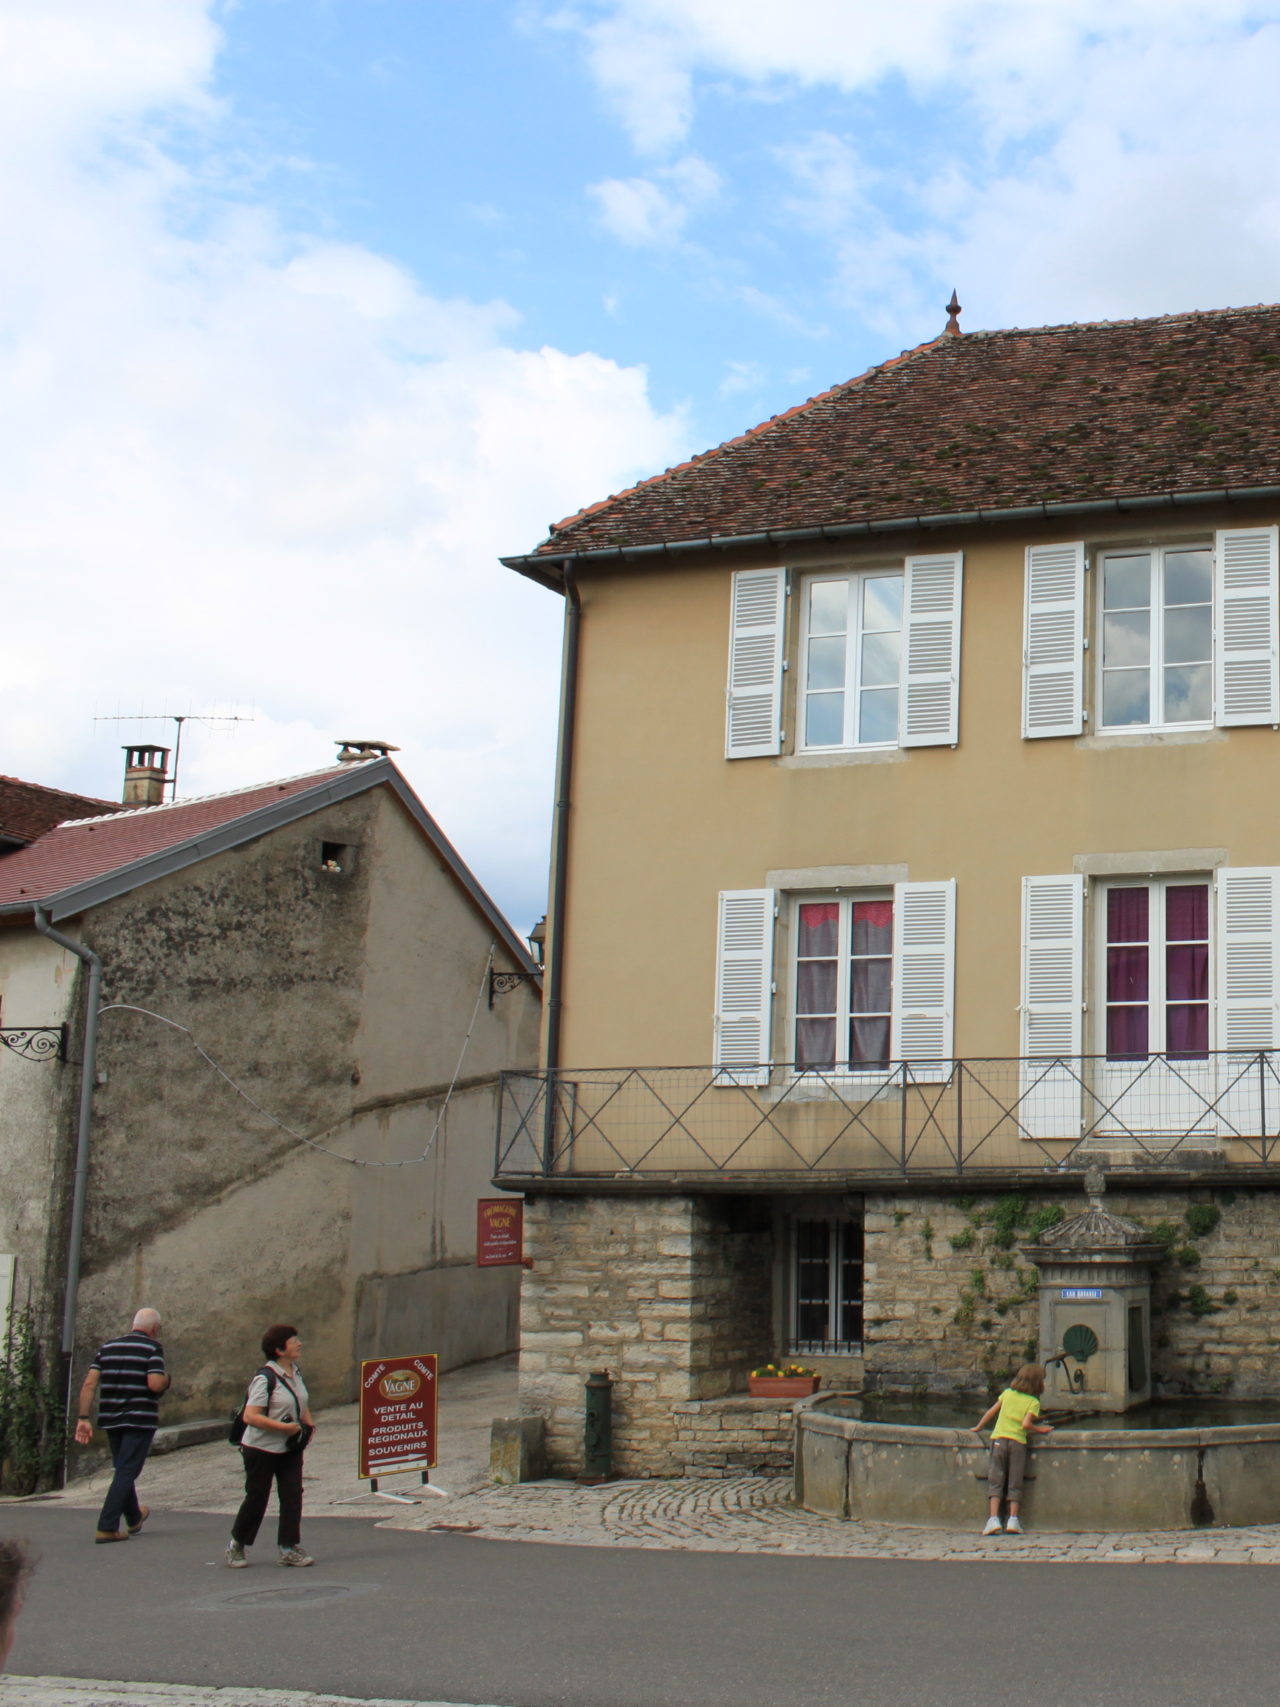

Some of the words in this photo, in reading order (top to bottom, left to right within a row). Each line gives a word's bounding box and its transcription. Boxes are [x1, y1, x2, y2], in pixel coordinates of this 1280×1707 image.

[489, 1217, 511, 1228] VAGNE
[364, 1363, 386, 1388] COMTE
[414, 1359, 434, 1381] COMTE
[384, 1379, 416, 1393] VAGNE
[374, 1403, 407, 1415] VENTE
[409, 1401, 424, 1410] AU
[381, 1411, 416, 1422] DETAIL
[372, 1421, 424, 1435] PRODUITS
[368, 1429, 428, 1444] REGIONAUX
[368, 1441, 427, 1456] SOUVENIRS
